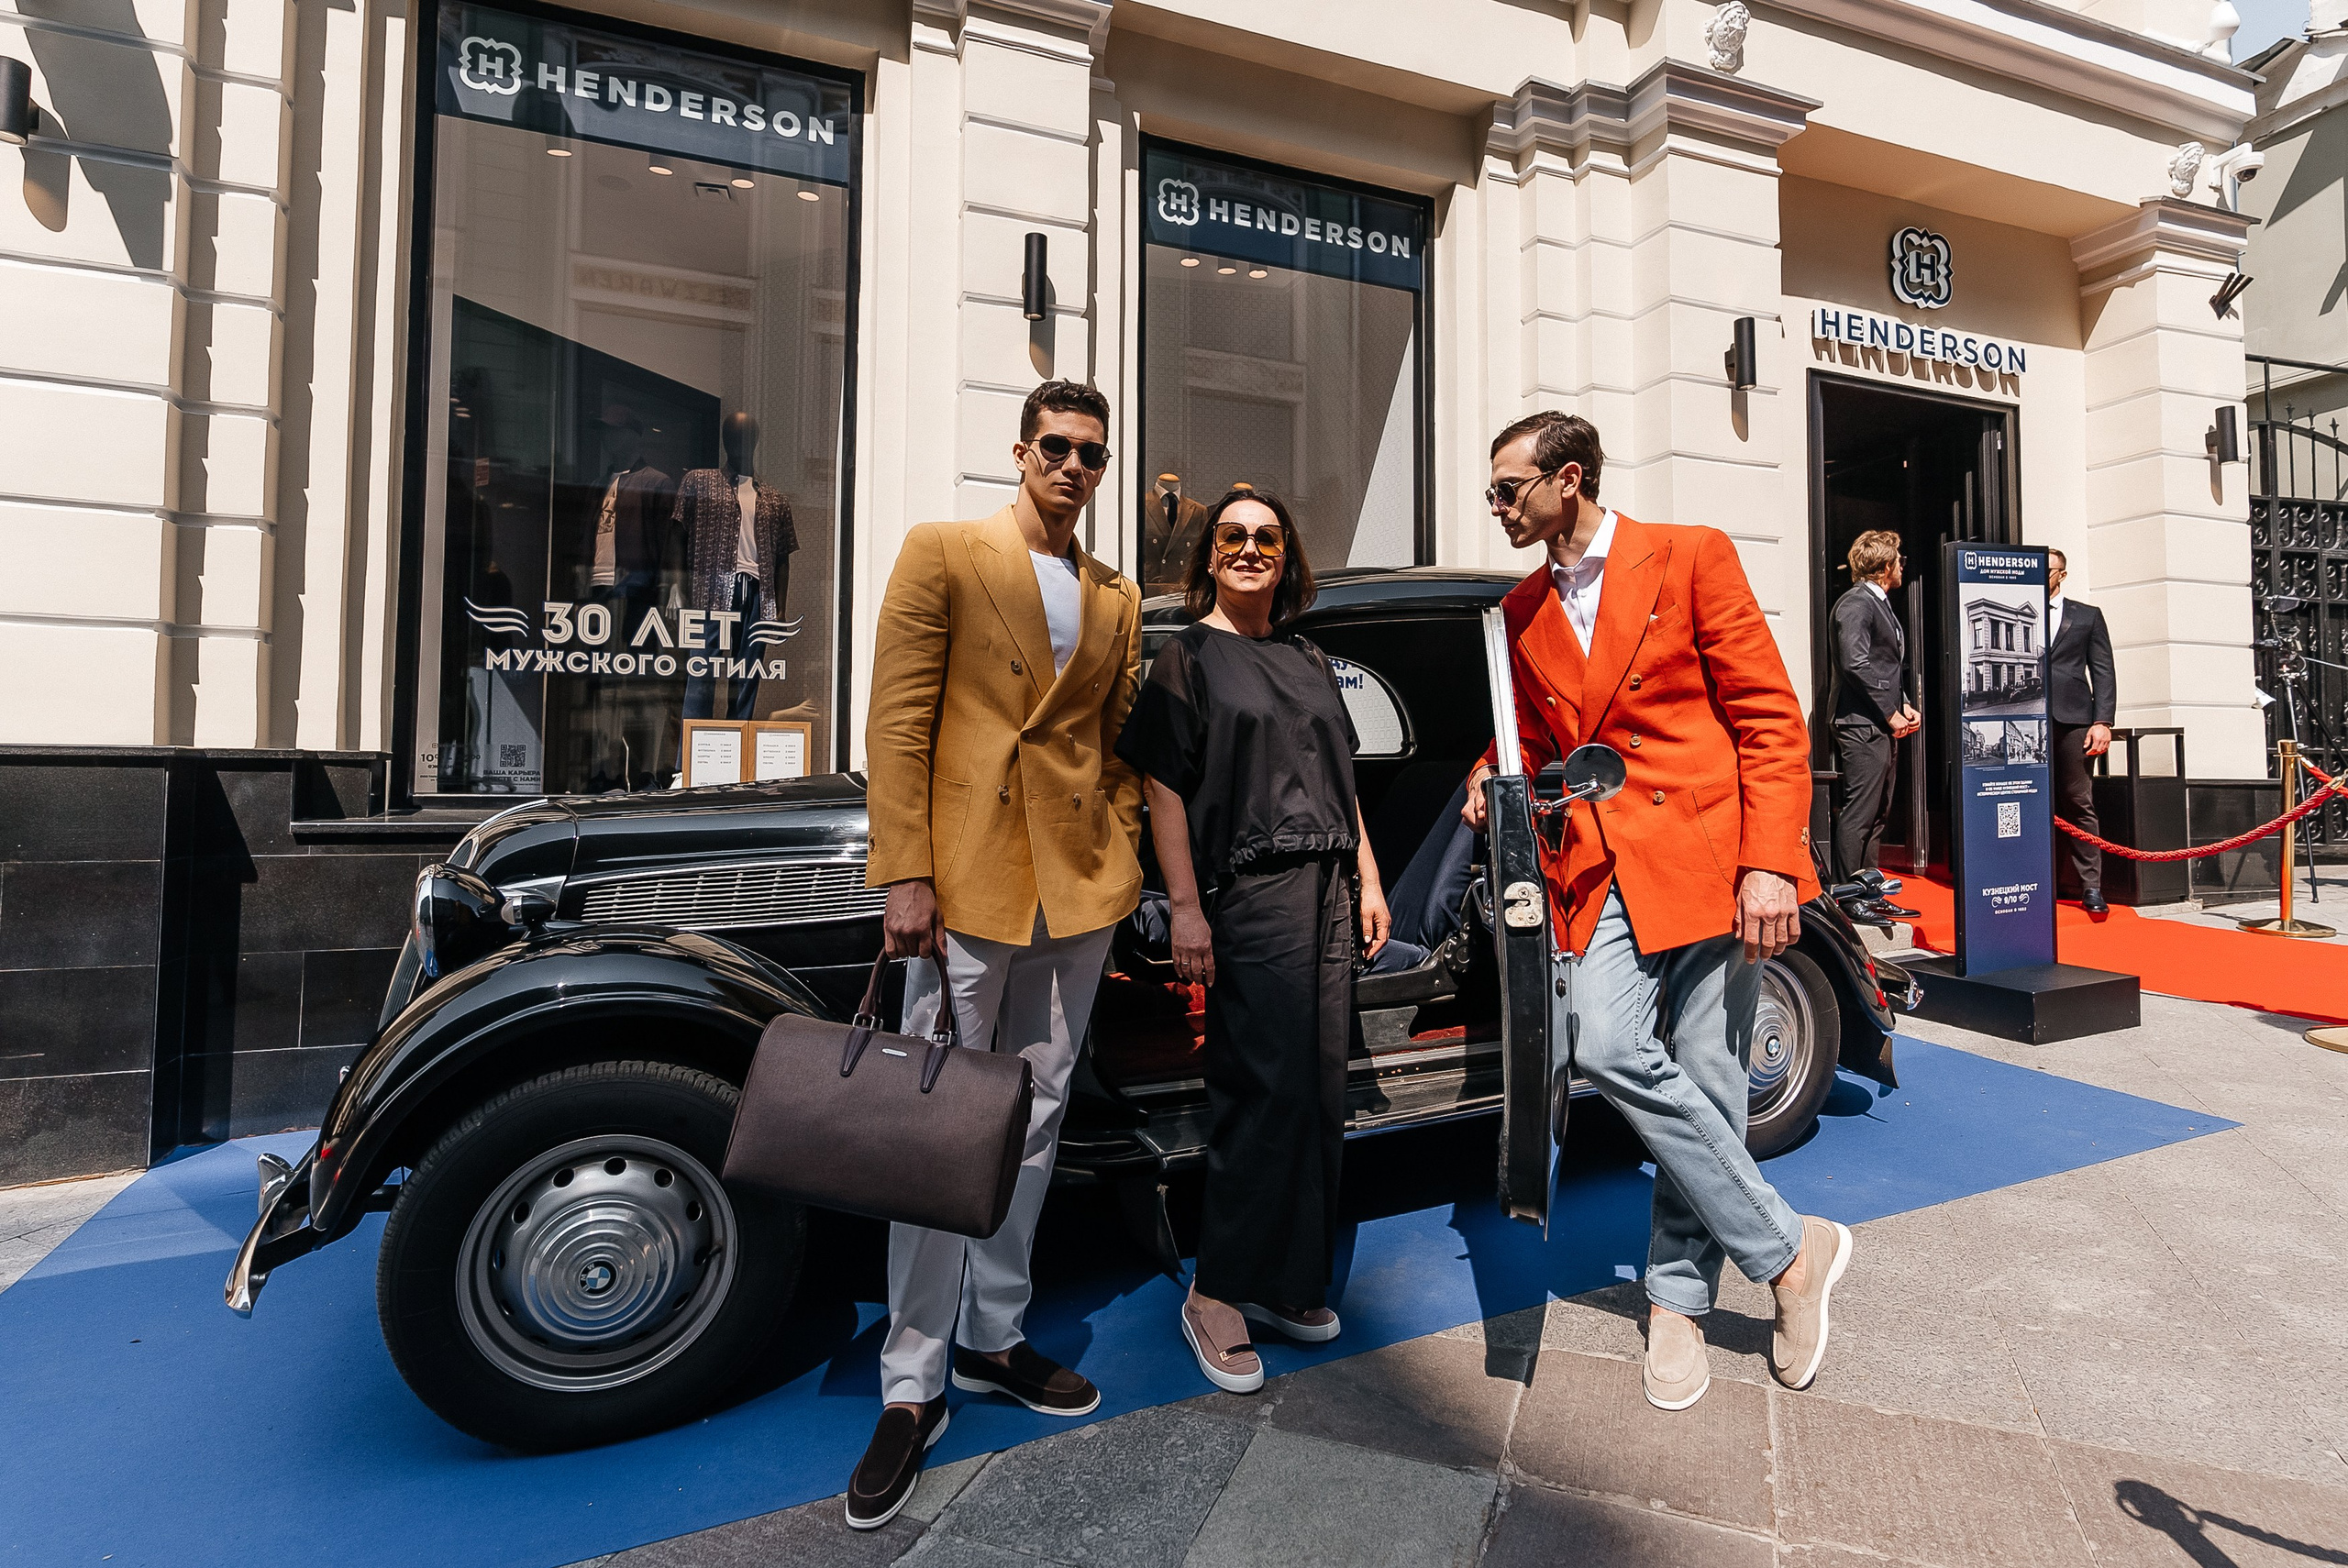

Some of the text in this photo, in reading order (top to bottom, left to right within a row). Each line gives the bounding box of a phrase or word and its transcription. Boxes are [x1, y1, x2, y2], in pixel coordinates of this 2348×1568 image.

[537, 61, 835, 146] HENDERSON
[1210, 197, 1410, 259] HENDERSON
[1814, 308, 2026, 374] HENDERSON
[1978, 556, 2038, 568] HENDERSON
[541, 601, 742, 651] 30 ЛЕТ
[485, 647, 787, 680] МУЖСКОГО СТИЛЯ
[1982, 883, 2038, 897] КУЗНЕЦКИЙ МОСТ
